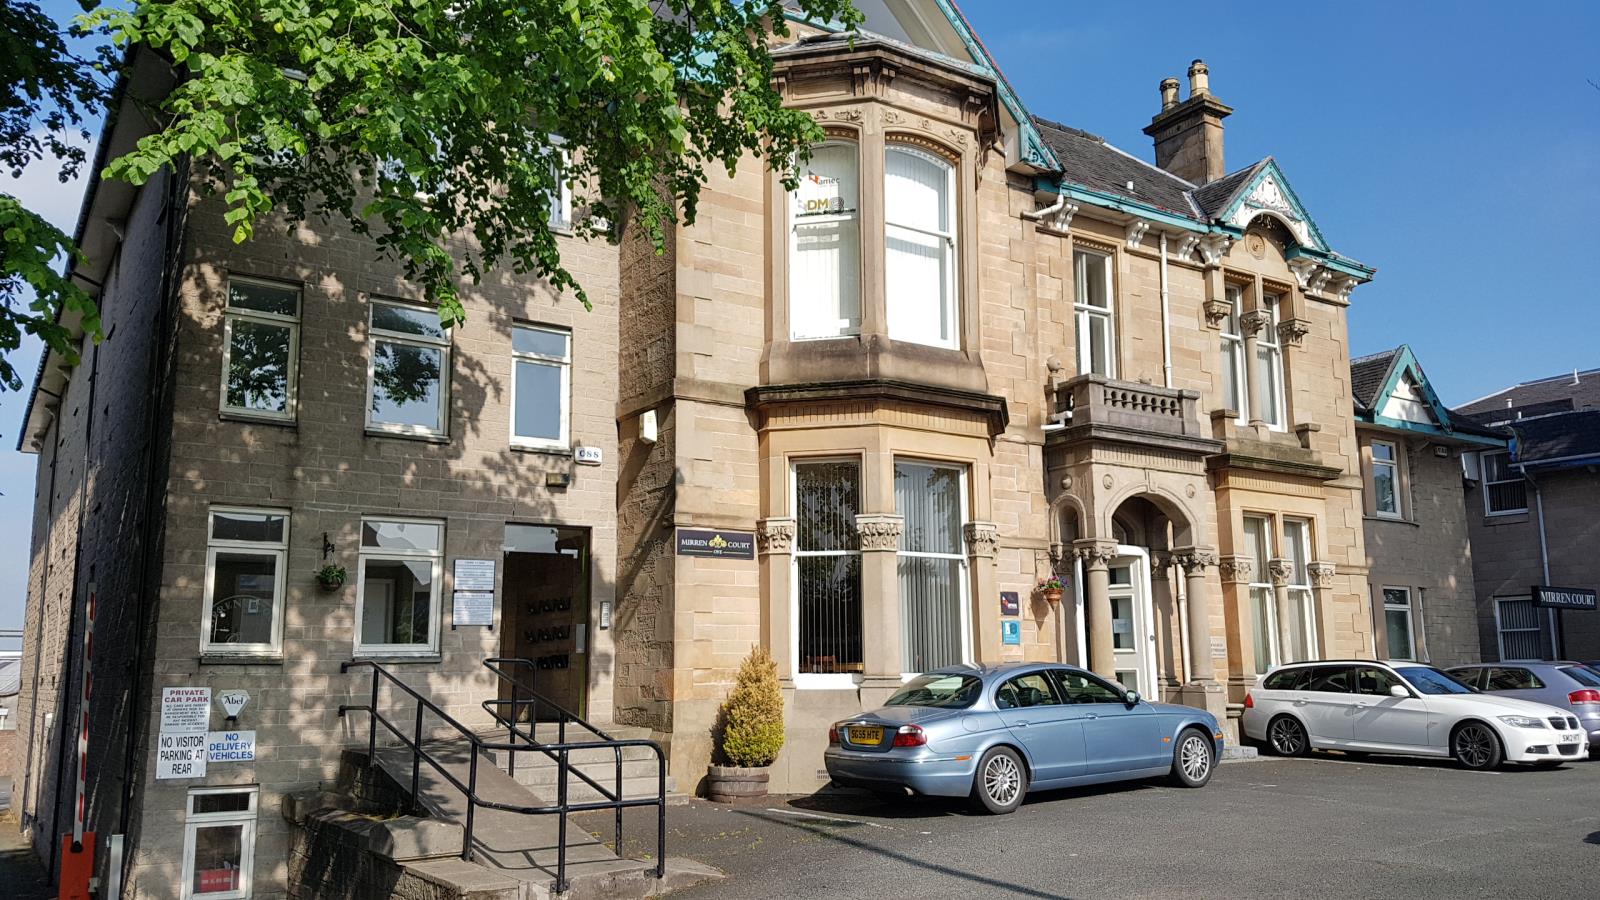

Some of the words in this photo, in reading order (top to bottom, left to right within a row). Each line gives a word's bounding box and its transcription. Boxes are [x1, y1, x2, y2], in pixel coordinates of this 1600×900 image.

[681, 538, 708, 547] MIRREN
[727, 541, 751, 549] COURT
[1540, 590, 1571, 604] MIRREN
[1571, 593, 1596, 606] COURT
[224, 695, 243, 705] Abel
[161, 737, 173, 748] NO
[176, 735, 204, 747] VISITOR
[225, 733, 239, 741] NO
[209, 742, 253, 751] DELIVERY
[160, 749, 192, 761] PARKING
[195, 749, 205, 760] AT
[209, 751, 253, 761] VEHICLES
[171, 763, 192, 775] REAR
